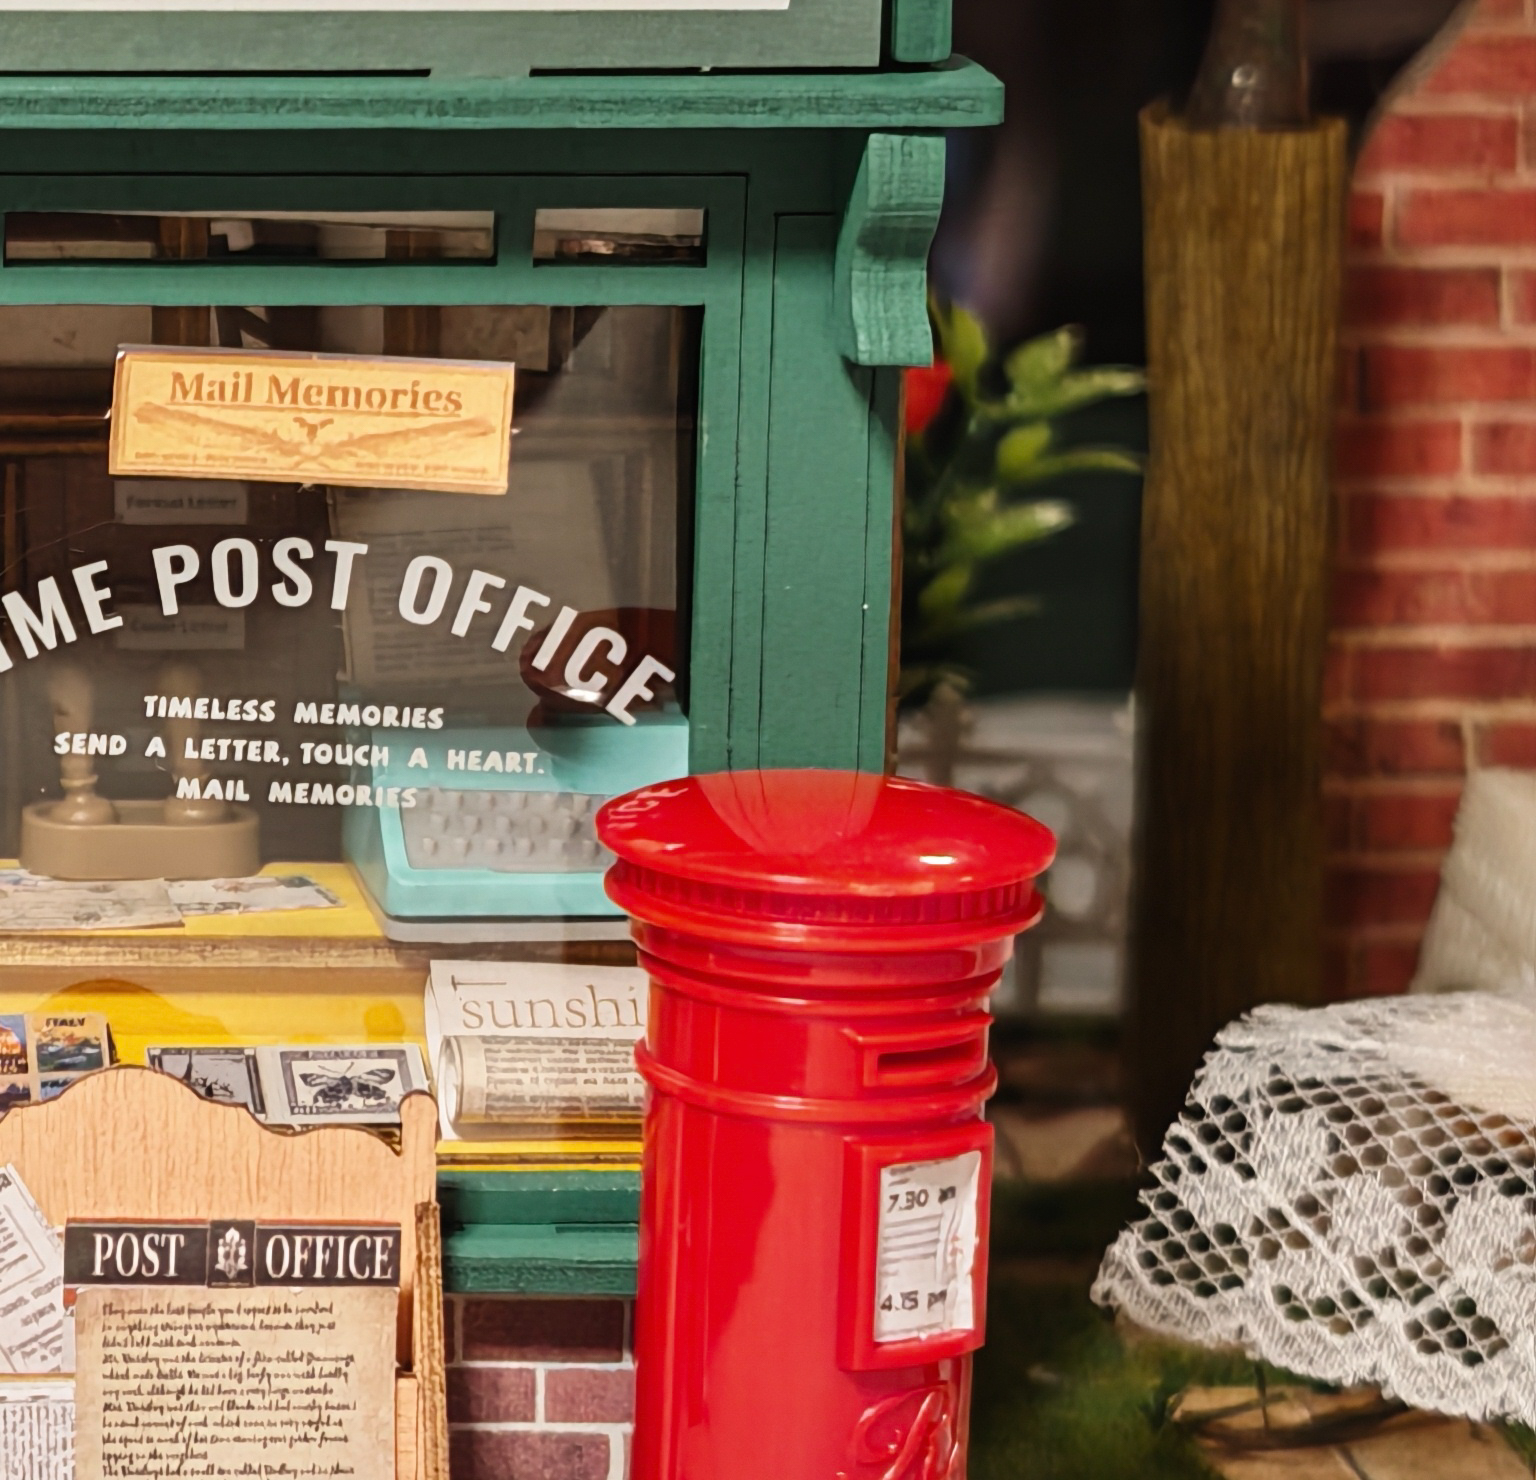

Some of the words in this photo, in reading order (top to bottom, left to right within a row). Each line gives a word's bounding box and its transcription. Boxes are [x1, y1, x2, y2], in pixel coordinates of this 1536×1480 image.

[169, 371, 253, 403] Mail
[267, 374, 464, 413] Memories
[152, 537, 368, 616] POST
[399, 555, 676, 726] OFFICE
[143, 695, 276, 723] TIMELESS
[293, 701, 445, 731] MEMORIES
[53, 731, 127, 757] SEND
[145, 733, 166, 758] A
[184, 737, 291, 767] LETTER,
[301, 741, 389, 768] TOUCH
[408, 746, 429, 769] A
[447, 749, 546, 775] HEART.
[176, 778, 250, 803] MAIL
[268, 782, 418, 809] MEMORIES
[92, 1232, 185, 1277] POST
[265, 1234, 394, 1280] OFFICE
